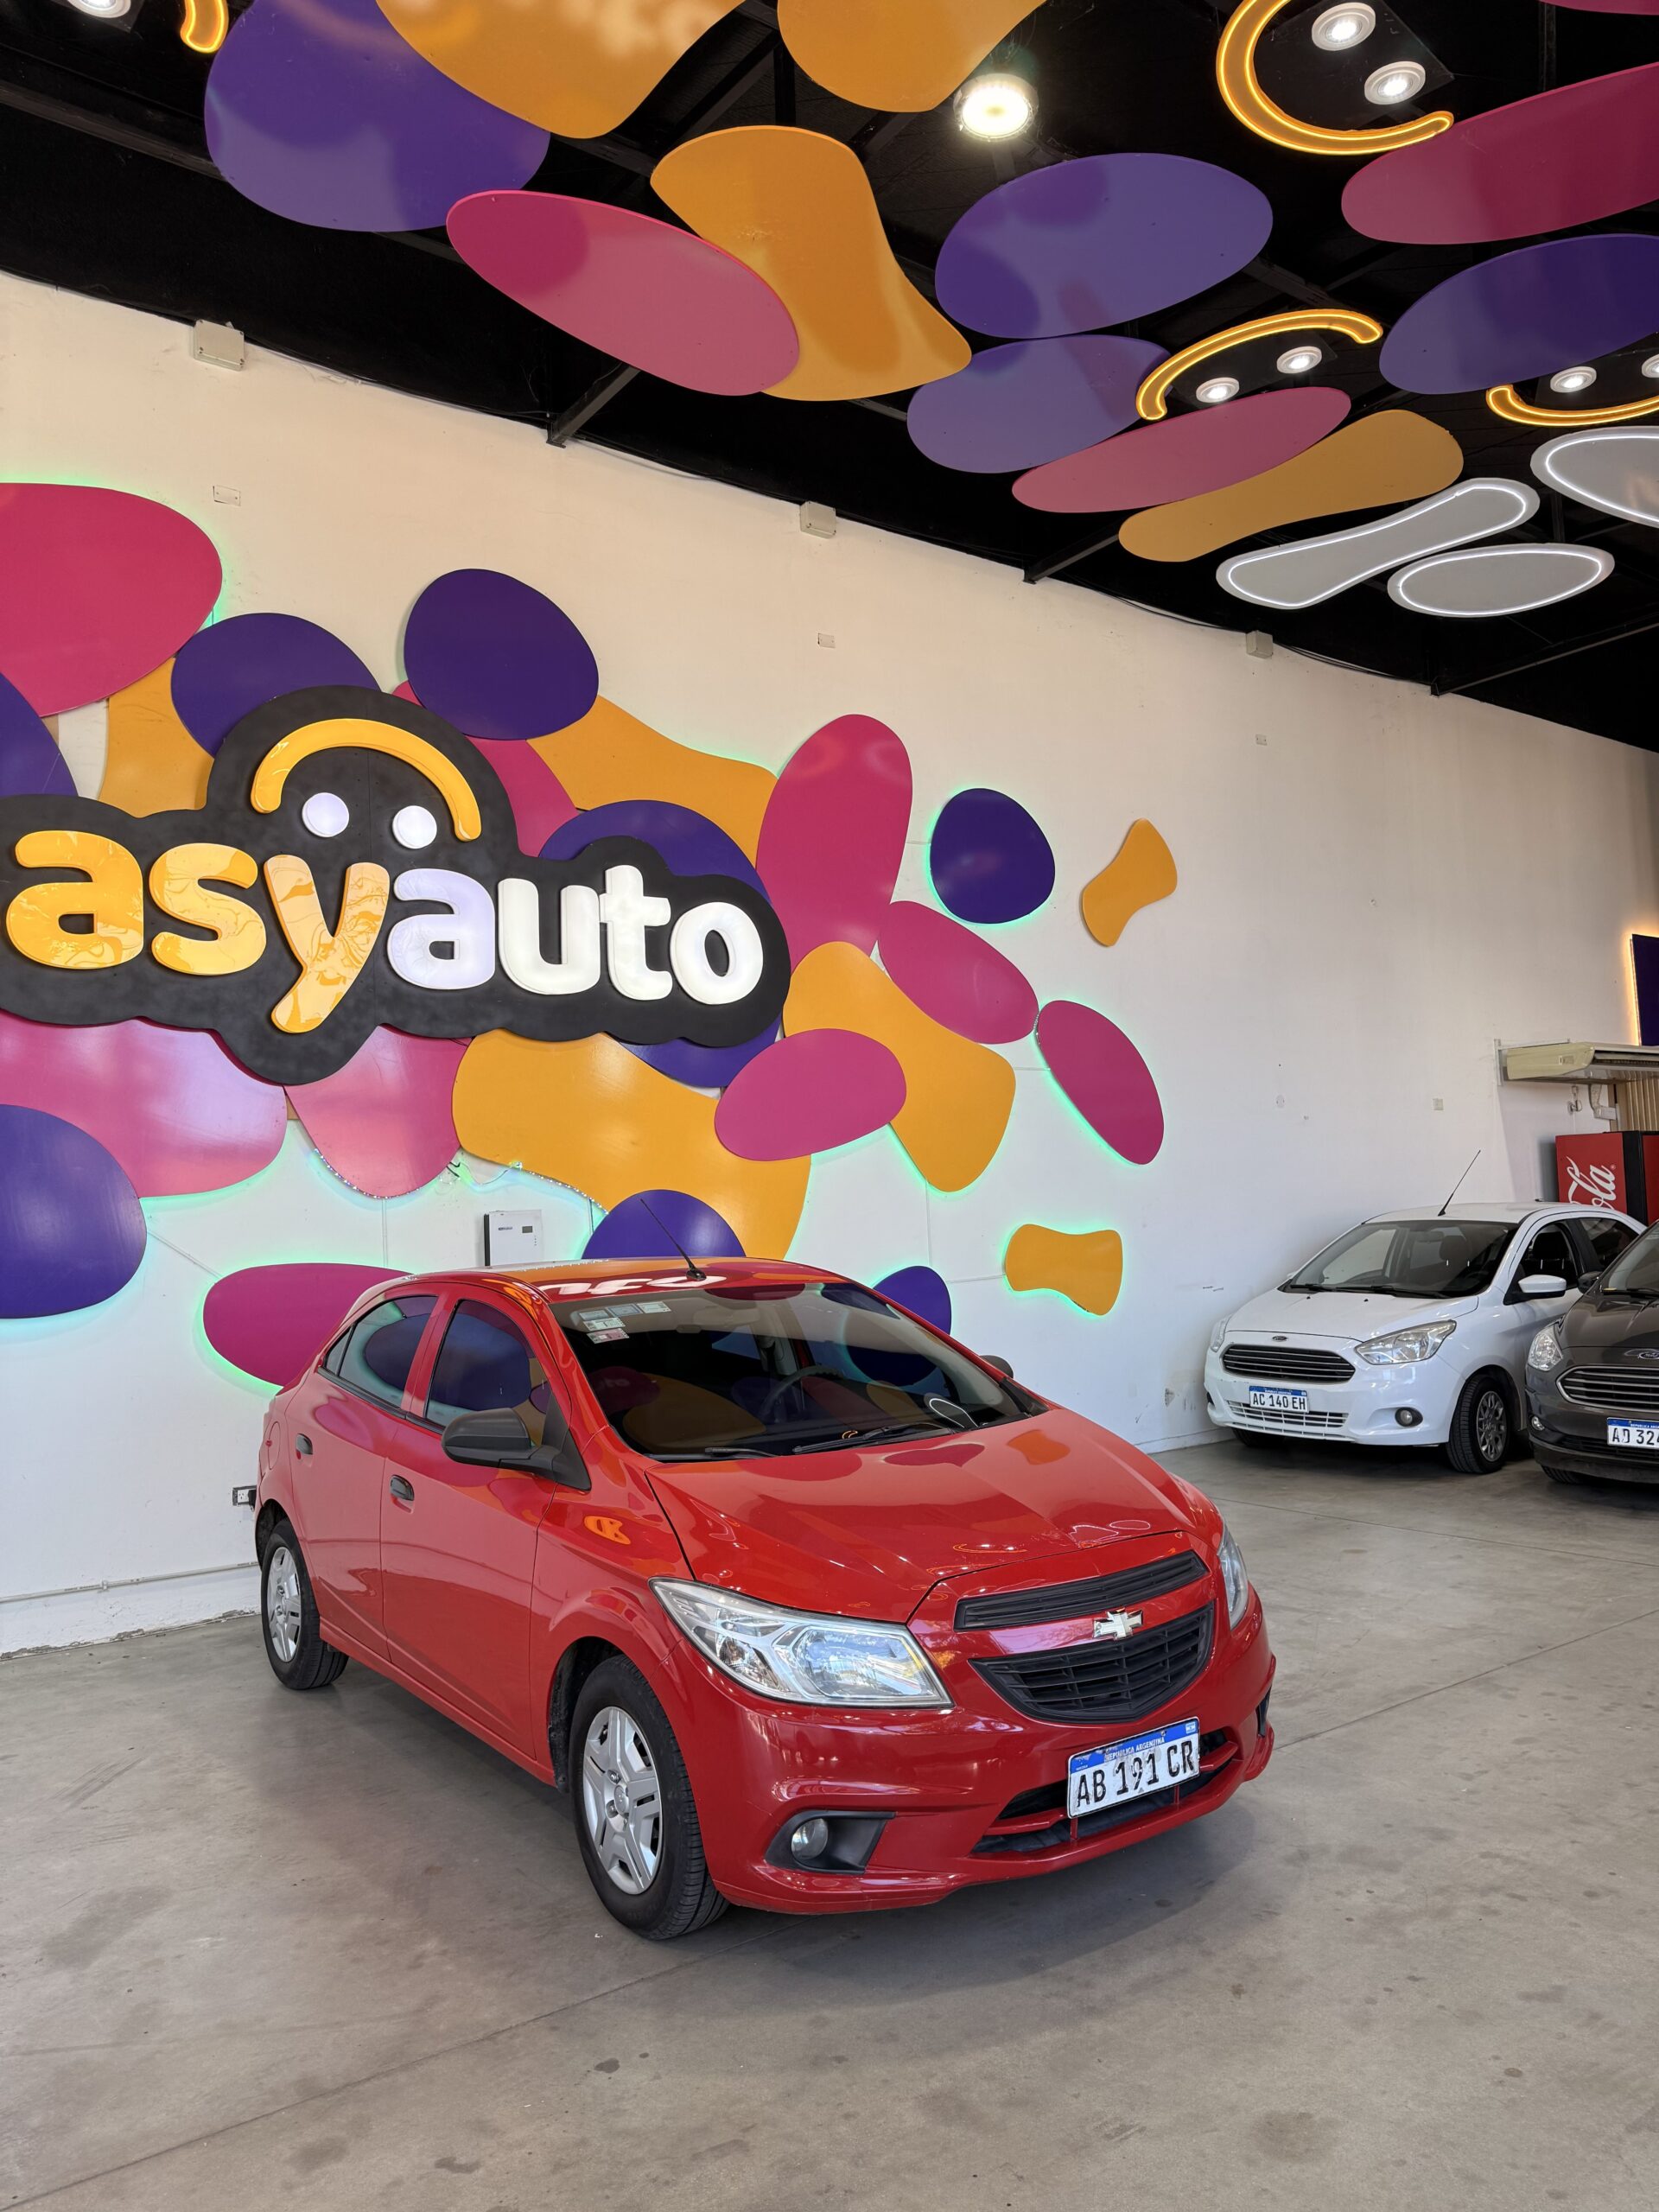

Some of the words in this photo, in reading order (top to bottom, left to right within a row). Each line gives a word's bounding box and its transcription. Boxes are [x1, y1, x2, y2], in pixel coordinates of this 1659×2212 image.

[5, 830, 764, 1033] asyauto
[1253, 1393, 1266, 1406] AC
[1268, 1395, 1288, 1408] 140
[1292, 1396, 1306, 1410] EH
[1135, 1737, 1165, 1752] ARGENTINA
[1077, 1769, 1107, 1808] AB
[1116, 1752, 1160, 1796] 191
[1166, 1740, 1195, 1777] CR
